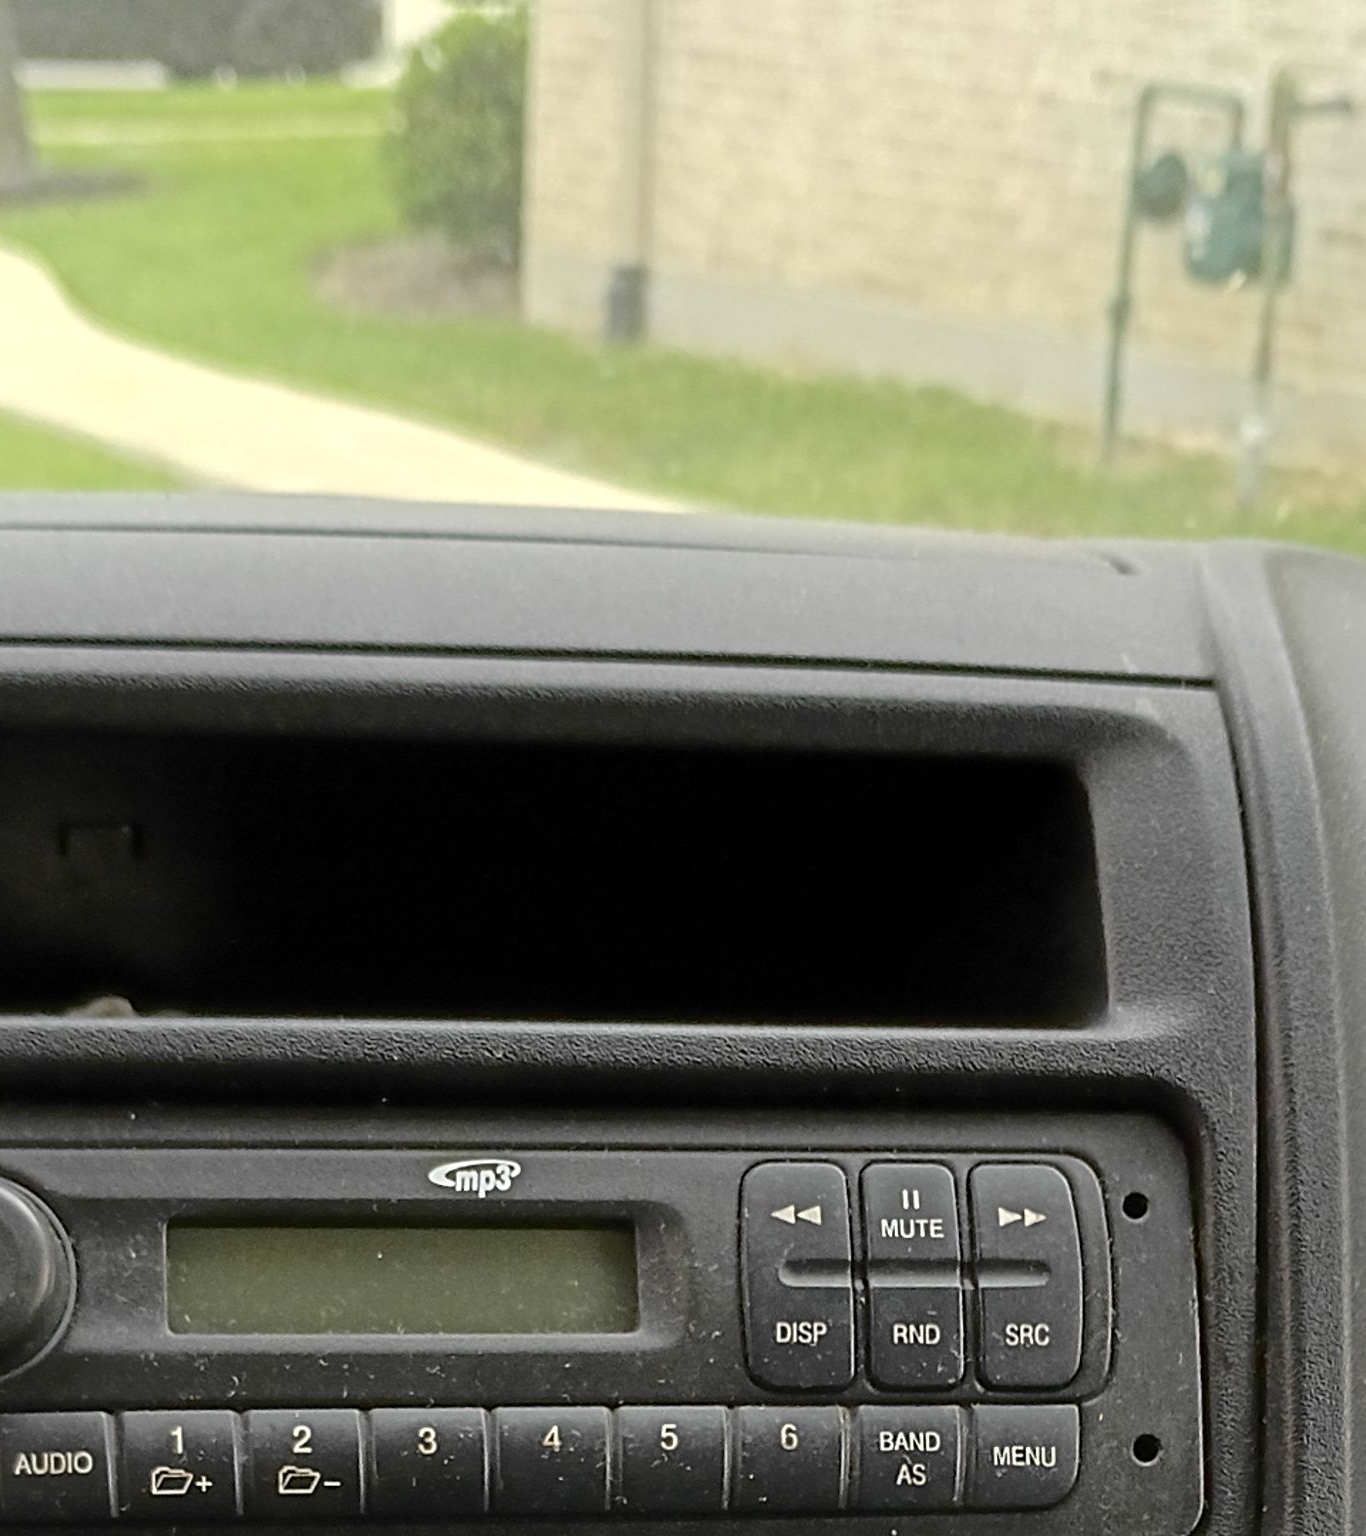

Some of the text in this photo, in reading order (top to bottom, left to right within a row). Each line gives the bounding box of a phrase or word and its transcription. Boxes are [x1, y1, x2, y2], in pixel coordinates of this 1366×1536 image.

[454, 1163, 512, 1199] mp3
[881, 1218, 945, 1239] MUTE
[776, 1321, 827, 1344] DISP
[893, 1323, 941, 1345] RND
[1005, 1323, 1050, 1346] SRC
[170, 1425, 183, 1454] 1
[292, 1424, 312, 1453] 2
[418, 1426, 437, 1455] 3
[543, 1424, 561, 1452] 4
[660, 1423, 679, 1450] 5
[780, 1423, 798, 1450] 6
[879, 1431, 941, 1452] BAND
[14, 1451, 93, 1475] AUDIO
[993, 1445, 1056, 1467] MENU
[896, 1463, 927, 1486] AS
